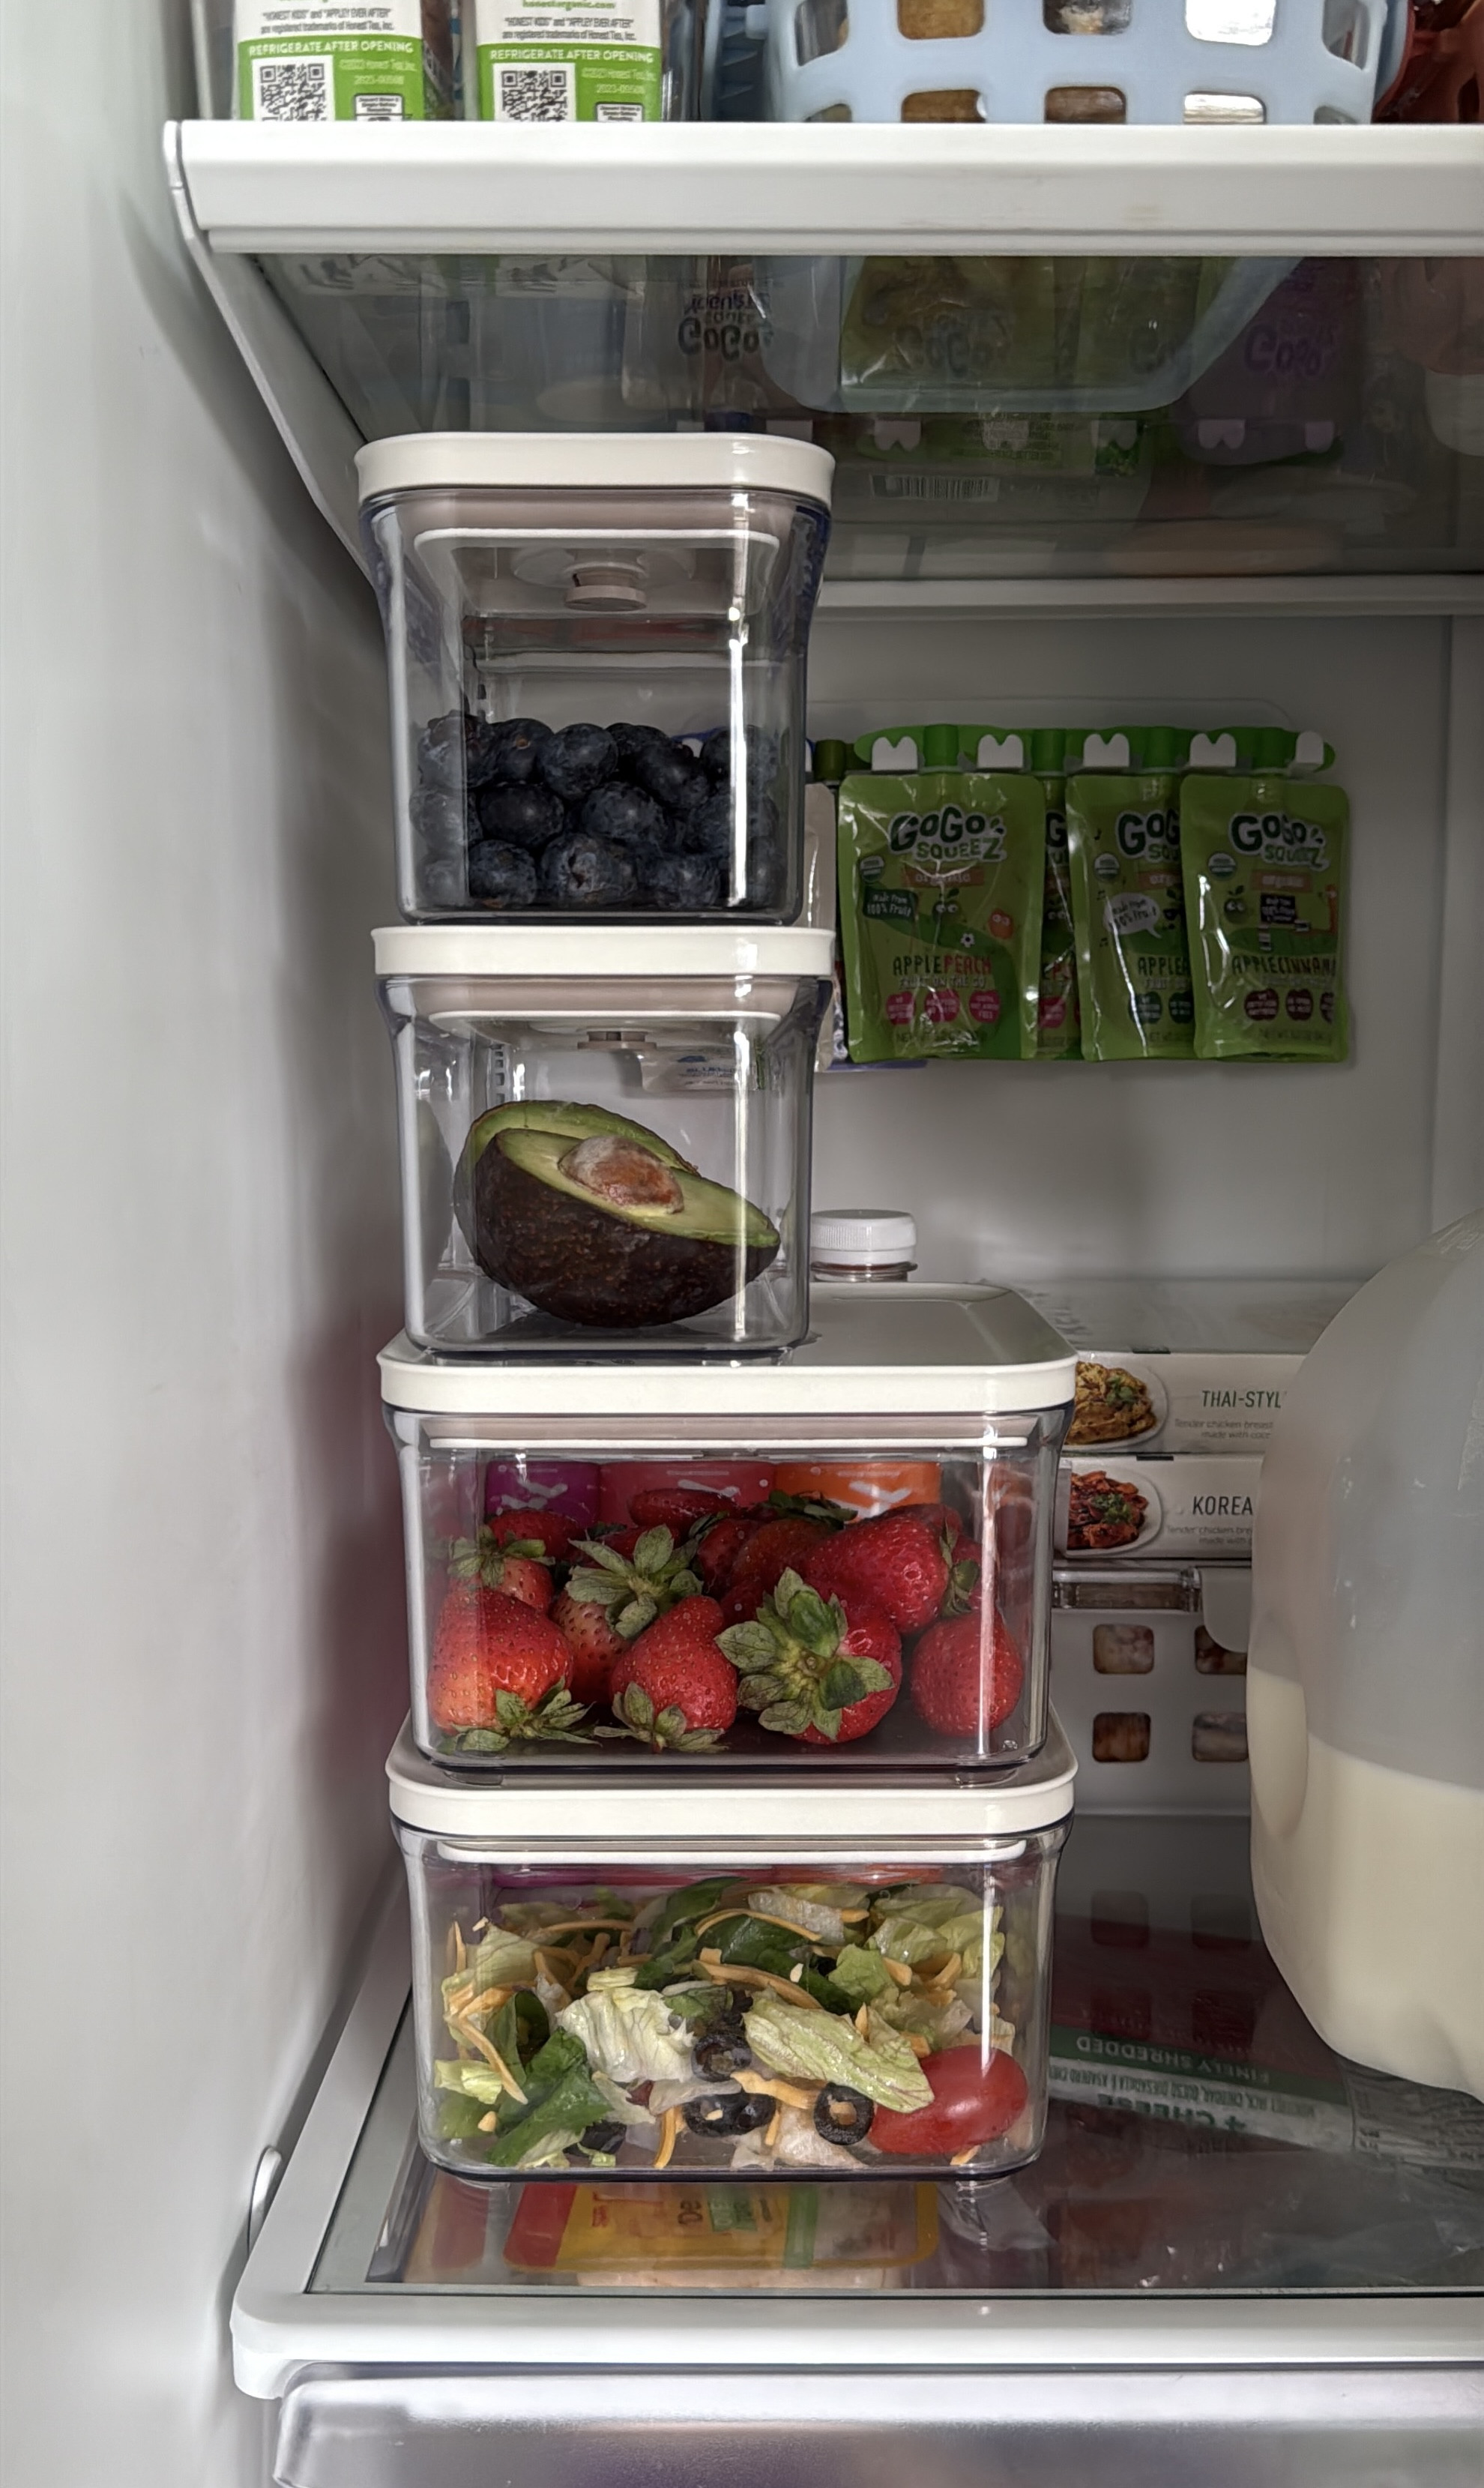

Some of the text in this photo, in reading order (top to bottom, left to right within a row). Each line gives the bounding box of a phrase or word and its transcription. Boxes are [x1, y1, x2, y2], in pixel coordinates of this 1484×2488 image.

[250, 40, 414, 57] REFRIGERATE AFTER OPENING
[490, 49, 654, 63] REFRIGERATE AFTER OPENING
[1118, 808, 1180, 855] GoG
[867, 903, 887, 915] 100%
[1202, 1390, 1282, 1409] THAI-STYL
[1174, 1418, 1204, 1429] Tender
[1205, 1420, 1240, 1429] chicken
[1228, 1430, 1248, 1439] with
[1192, 1495, 1253, 1516] KOREA
[1198, 1526, 1234, 1535] chicken
[1076, 2035, 1270, 2085] FINELY SHREDDED
